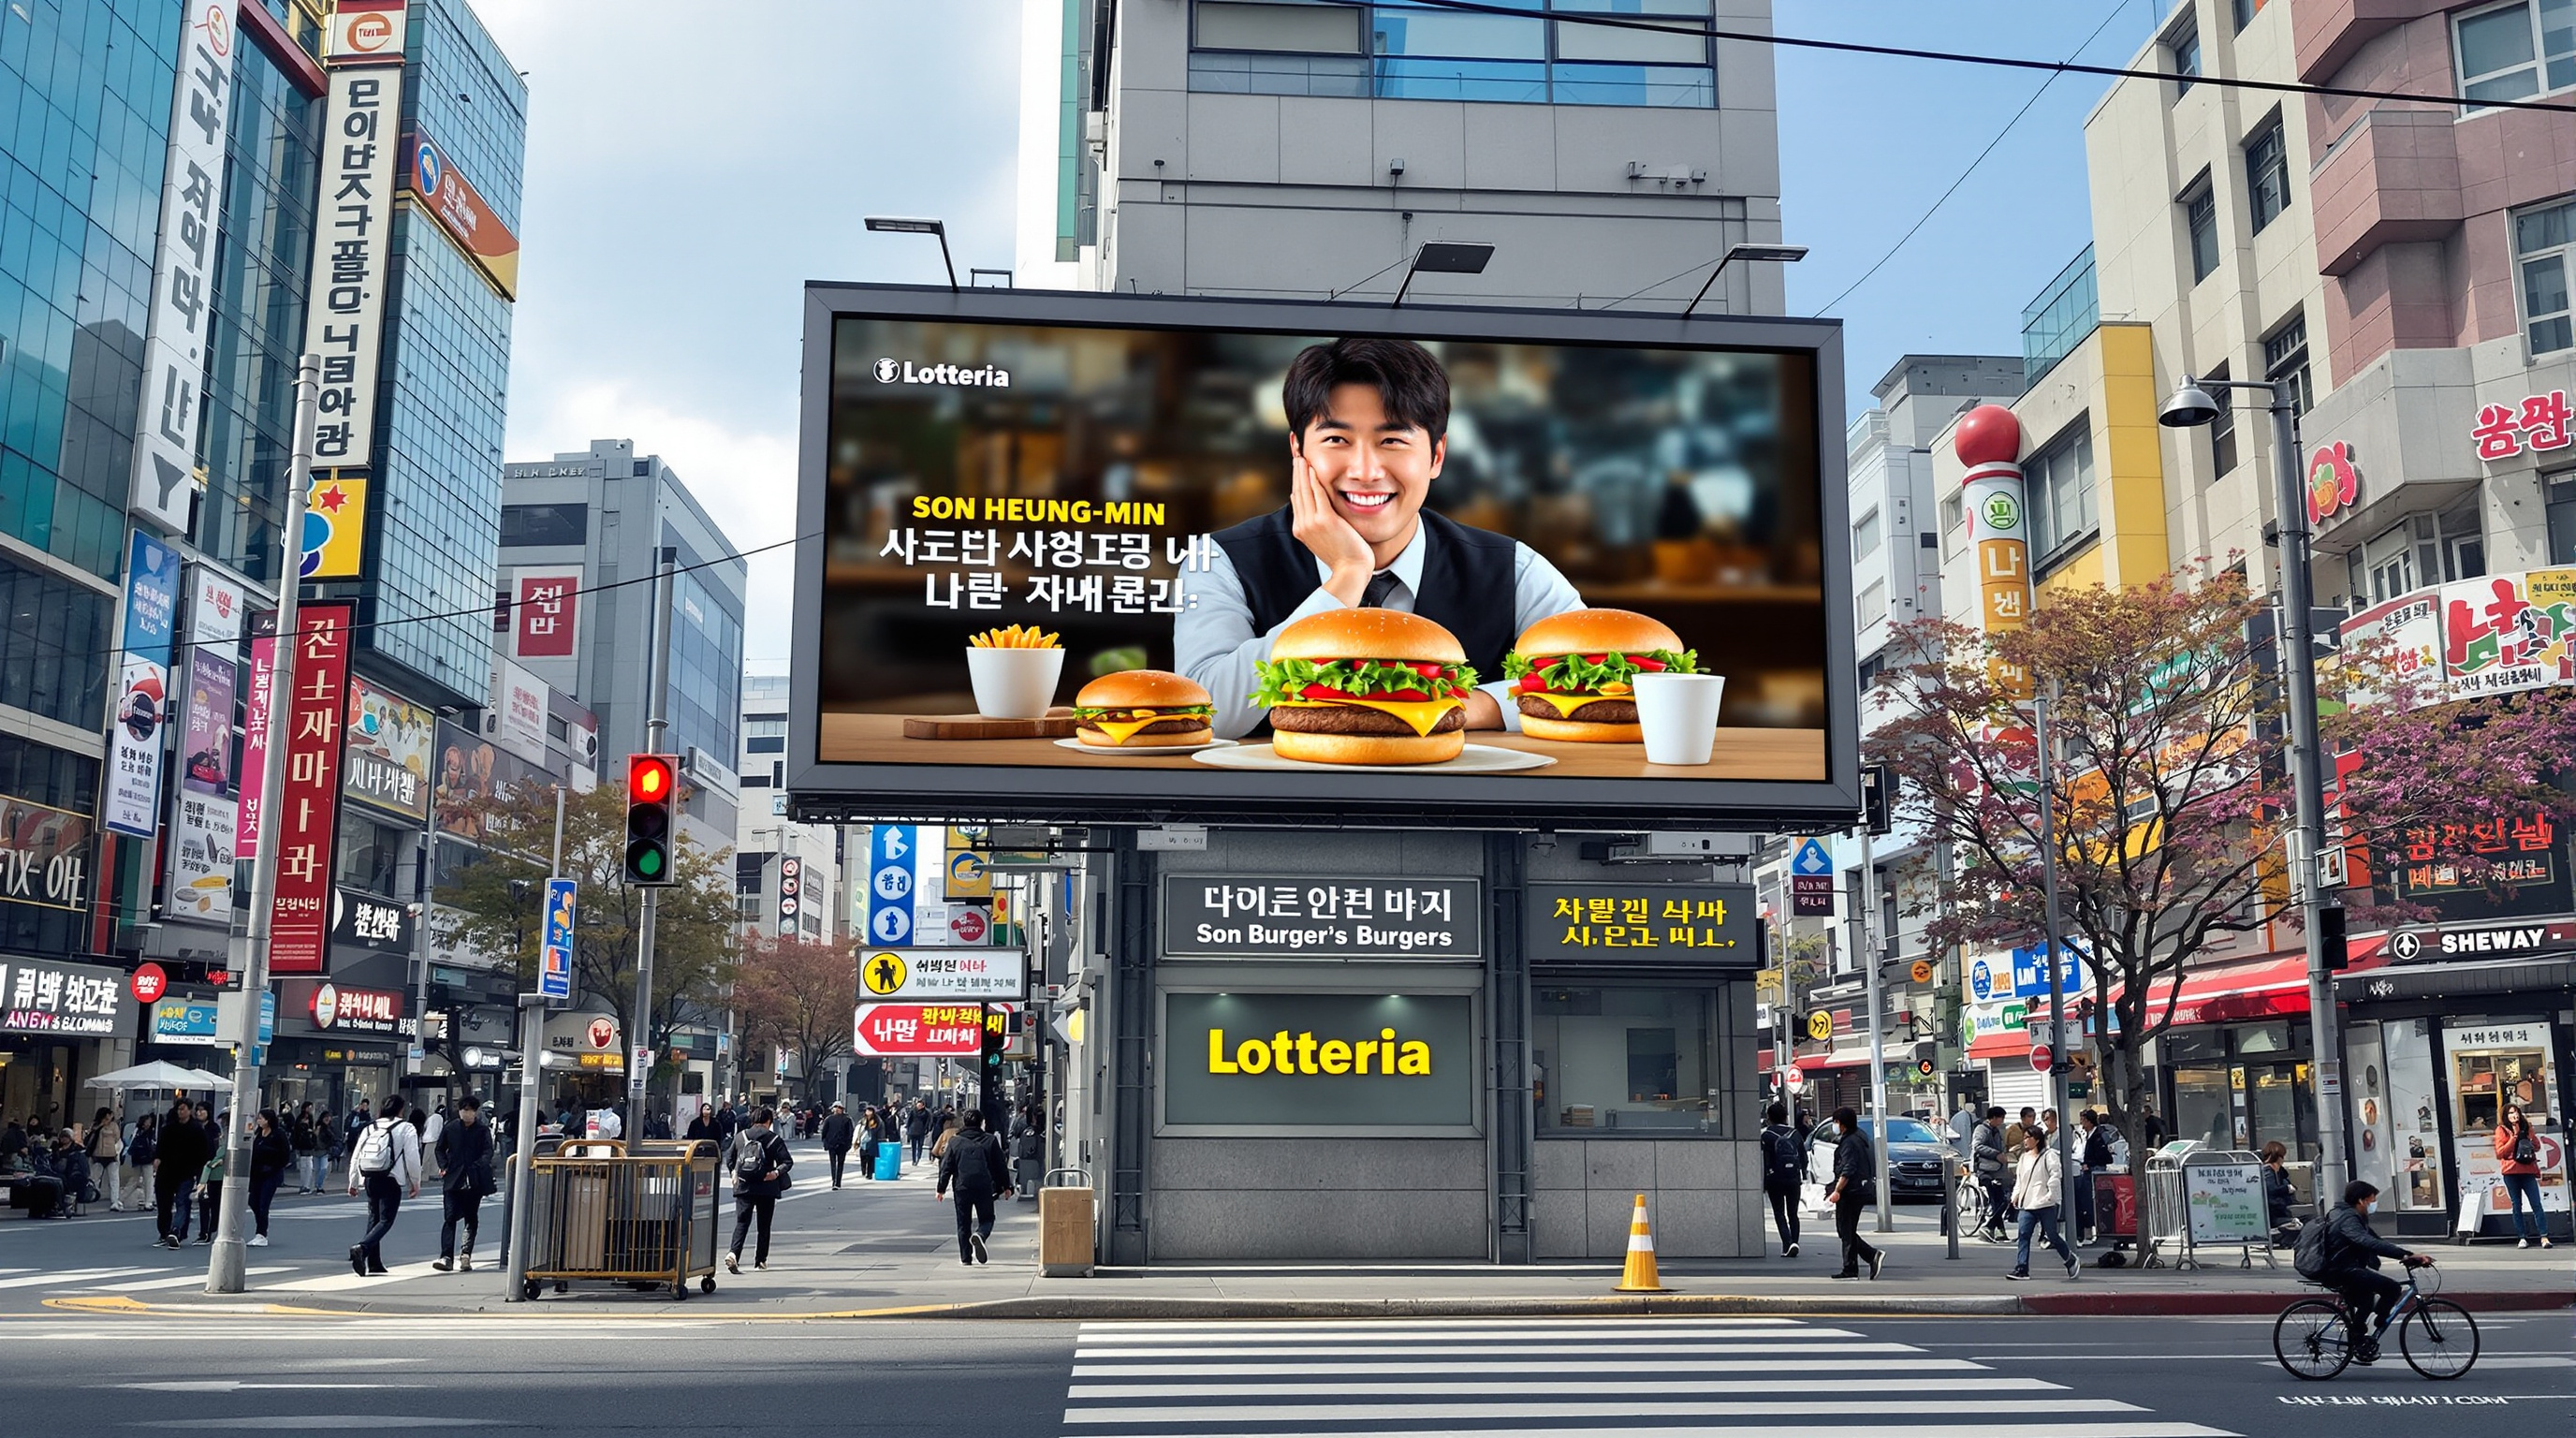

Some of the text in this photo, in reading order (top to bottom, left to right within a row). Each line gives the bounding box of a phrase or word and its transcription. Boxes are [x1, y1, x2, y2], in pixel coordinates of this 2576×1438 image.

[902, 360, 1010, 388] Lotteria
[912, 495, 1165, 526] SON HEUNG-MIN
[1196, 923, 1453, 950] Son Burger's Burgers
[2441, 929, 2545, 954] SHEWAY
[1208, 1027, 1431, 1075] Lotteria
